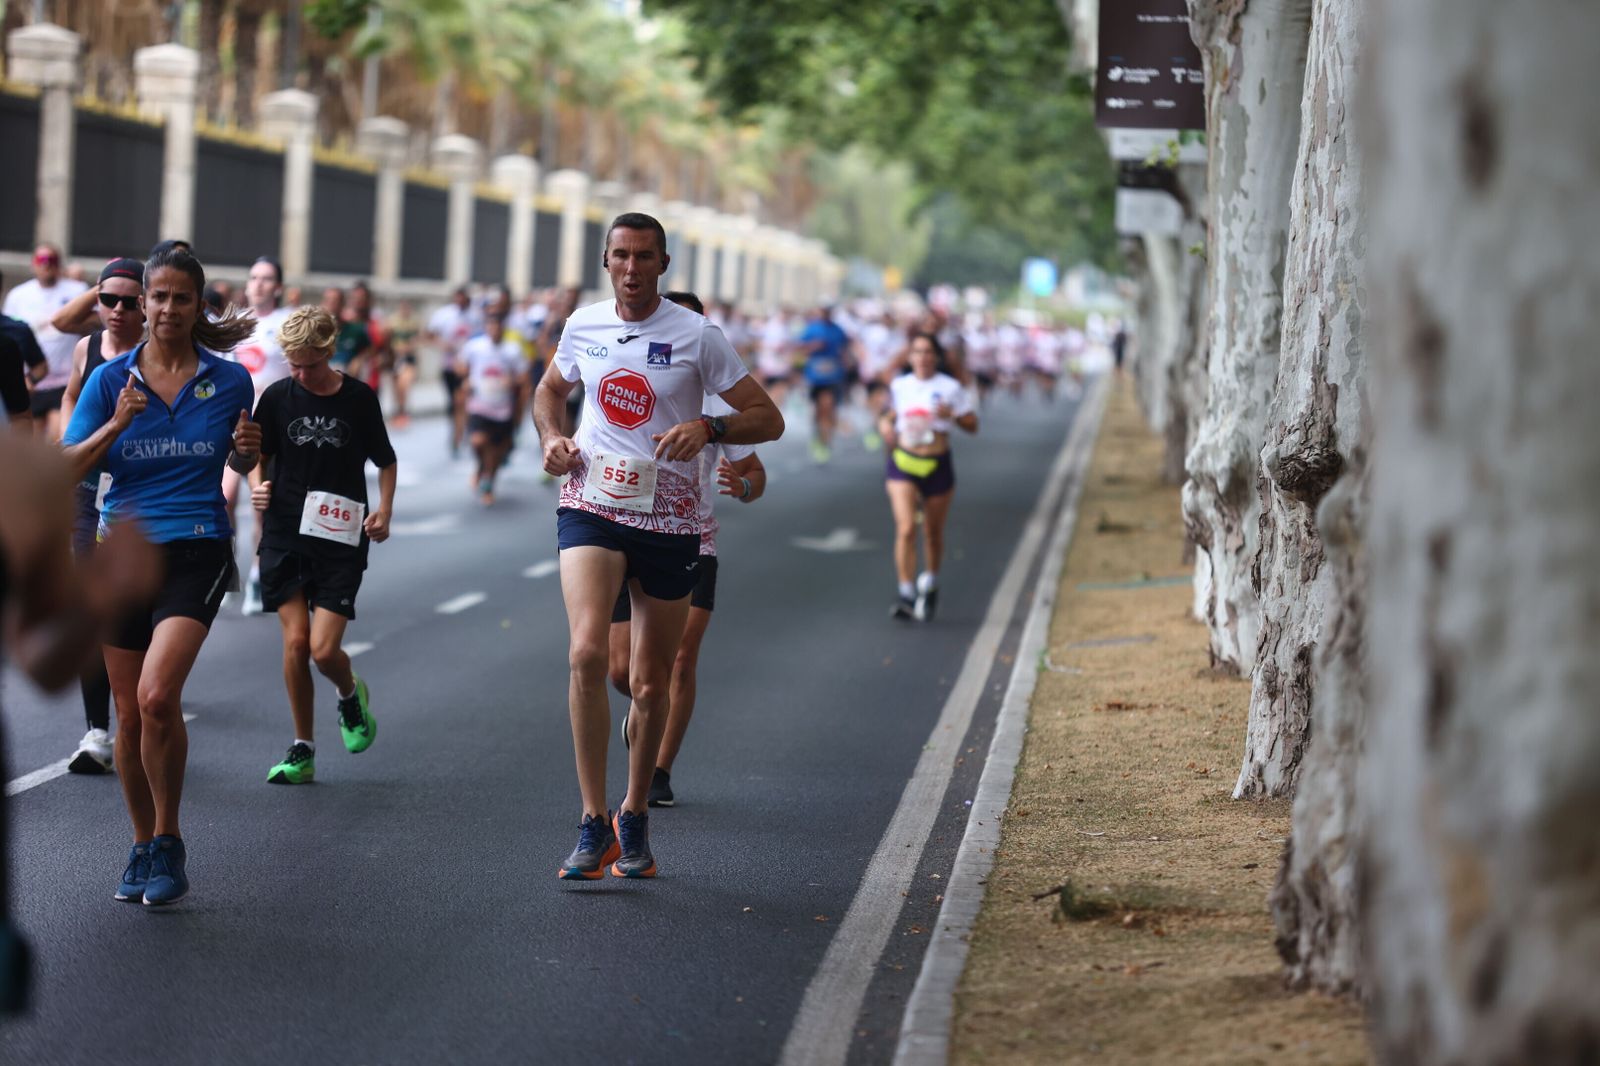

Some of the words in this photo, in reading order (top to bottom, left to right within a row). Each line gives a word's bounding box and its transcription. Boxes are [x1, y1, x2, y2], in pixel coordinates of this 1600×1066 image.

[647, 353, 667, 363] AXA
[606, 382, 648, 405] PONLE
[604, 393, 645, 416] FRENO
[123, 438, 169, 447] DISFRUTA
[603, 466, 640, 486] 552
[319, 504, 351, 522] 846
